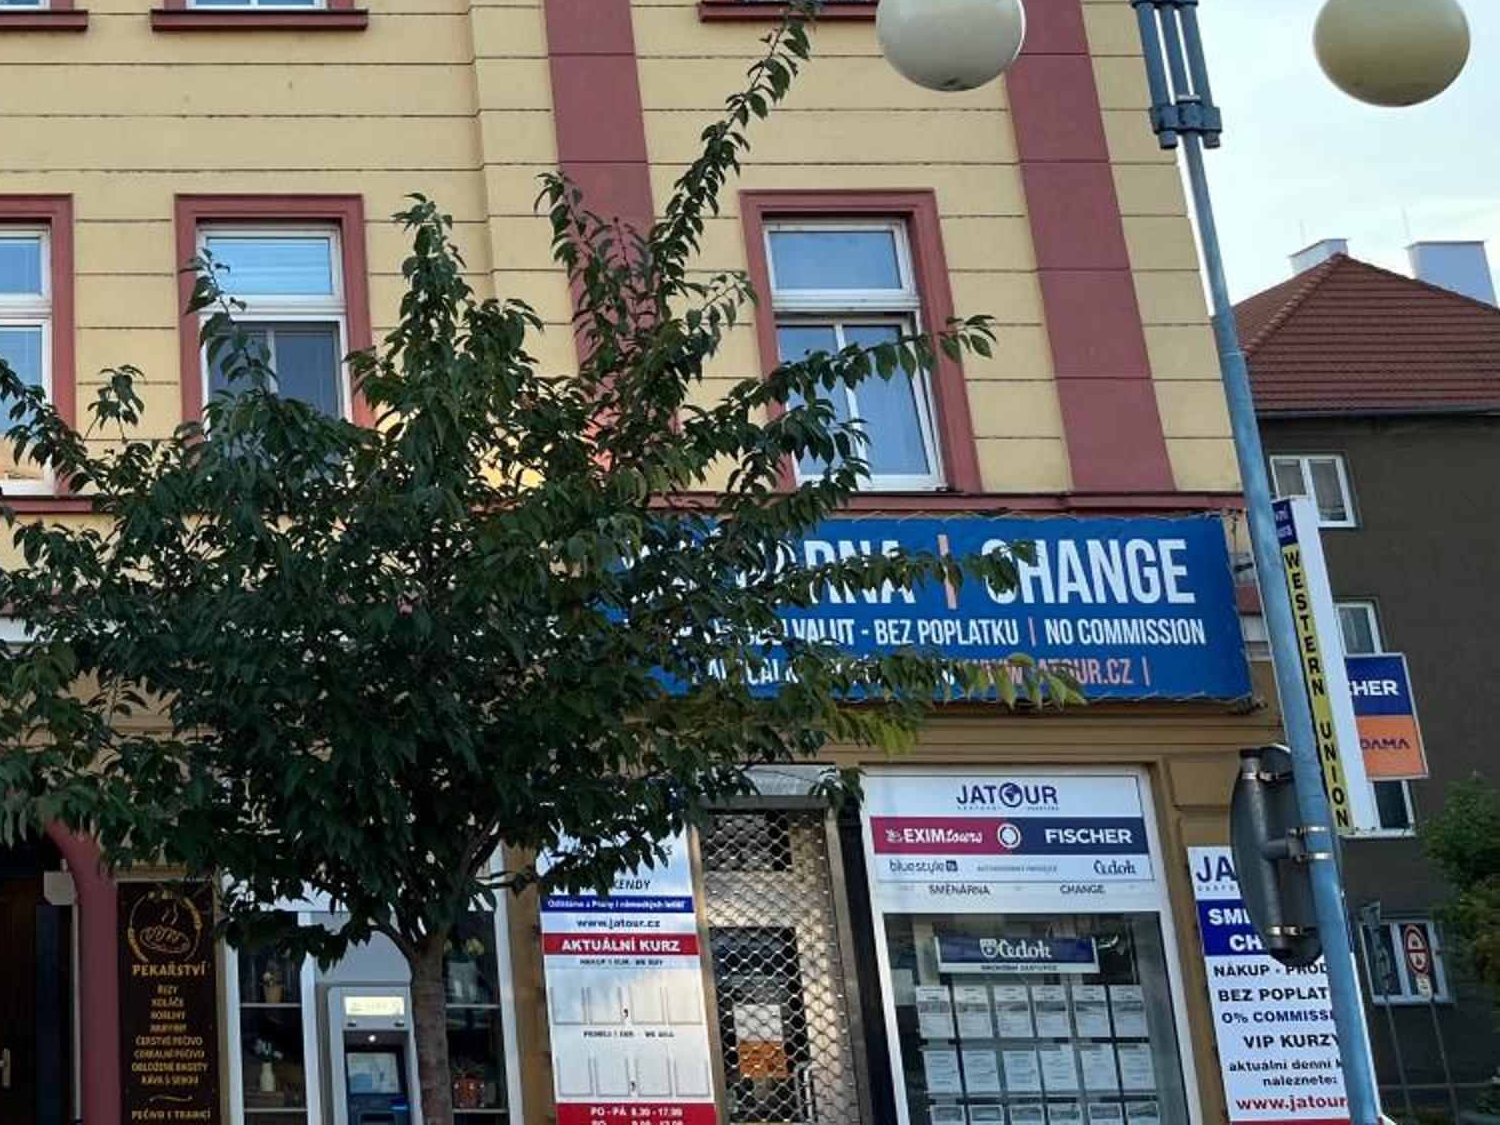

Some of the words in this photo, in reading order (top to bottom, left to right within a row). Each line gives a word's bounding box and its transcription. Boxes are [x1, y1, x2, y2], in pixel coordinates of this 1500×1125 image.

[981, 538, 1197, 605] CHANGE
[874, 618, 915, 645] BEZ
[918, 618, 1019, 646] POPLATKU
[1044, 618, 1074, 645] NO
[1078, 618, 1206, 645] COMMISSION
[1284, 549, 1325, 696] WESTERN
[1320, 722, 1349, 828] UNION
[1349, 680, 1398, 696] HER
[1044, 828, 1133, 844] FISCHER
[1060, 883, 1106, 895] CHANGE
[576, 918, 661, 929] www.jatour.cz
[561, 937, 635, 952] AKTUÁLNÍ
[640, 939, 682, 952] KURZ
[132, 961, 207, 976] PEKAŘSTVÍ
[1213, 962, 1271, 978] NÁKUP
[1285, 963, 1328, 976] PROD
[1218, 988, 1254, 1002] BEZ
[1259, 986, 1329, 1001] POPLAT
[1221, 1011, 1249, 1024] 0%
[1253, 1009, 1334, 1024] COMMISSI
[1243, 1035, 1275, 1049] VIP
[1281, 1033, 1340, 1048] KURZY
[1291, 1057, 1331, 1071] denní
[1262, 1073, 1338, 1087] naleznete:
